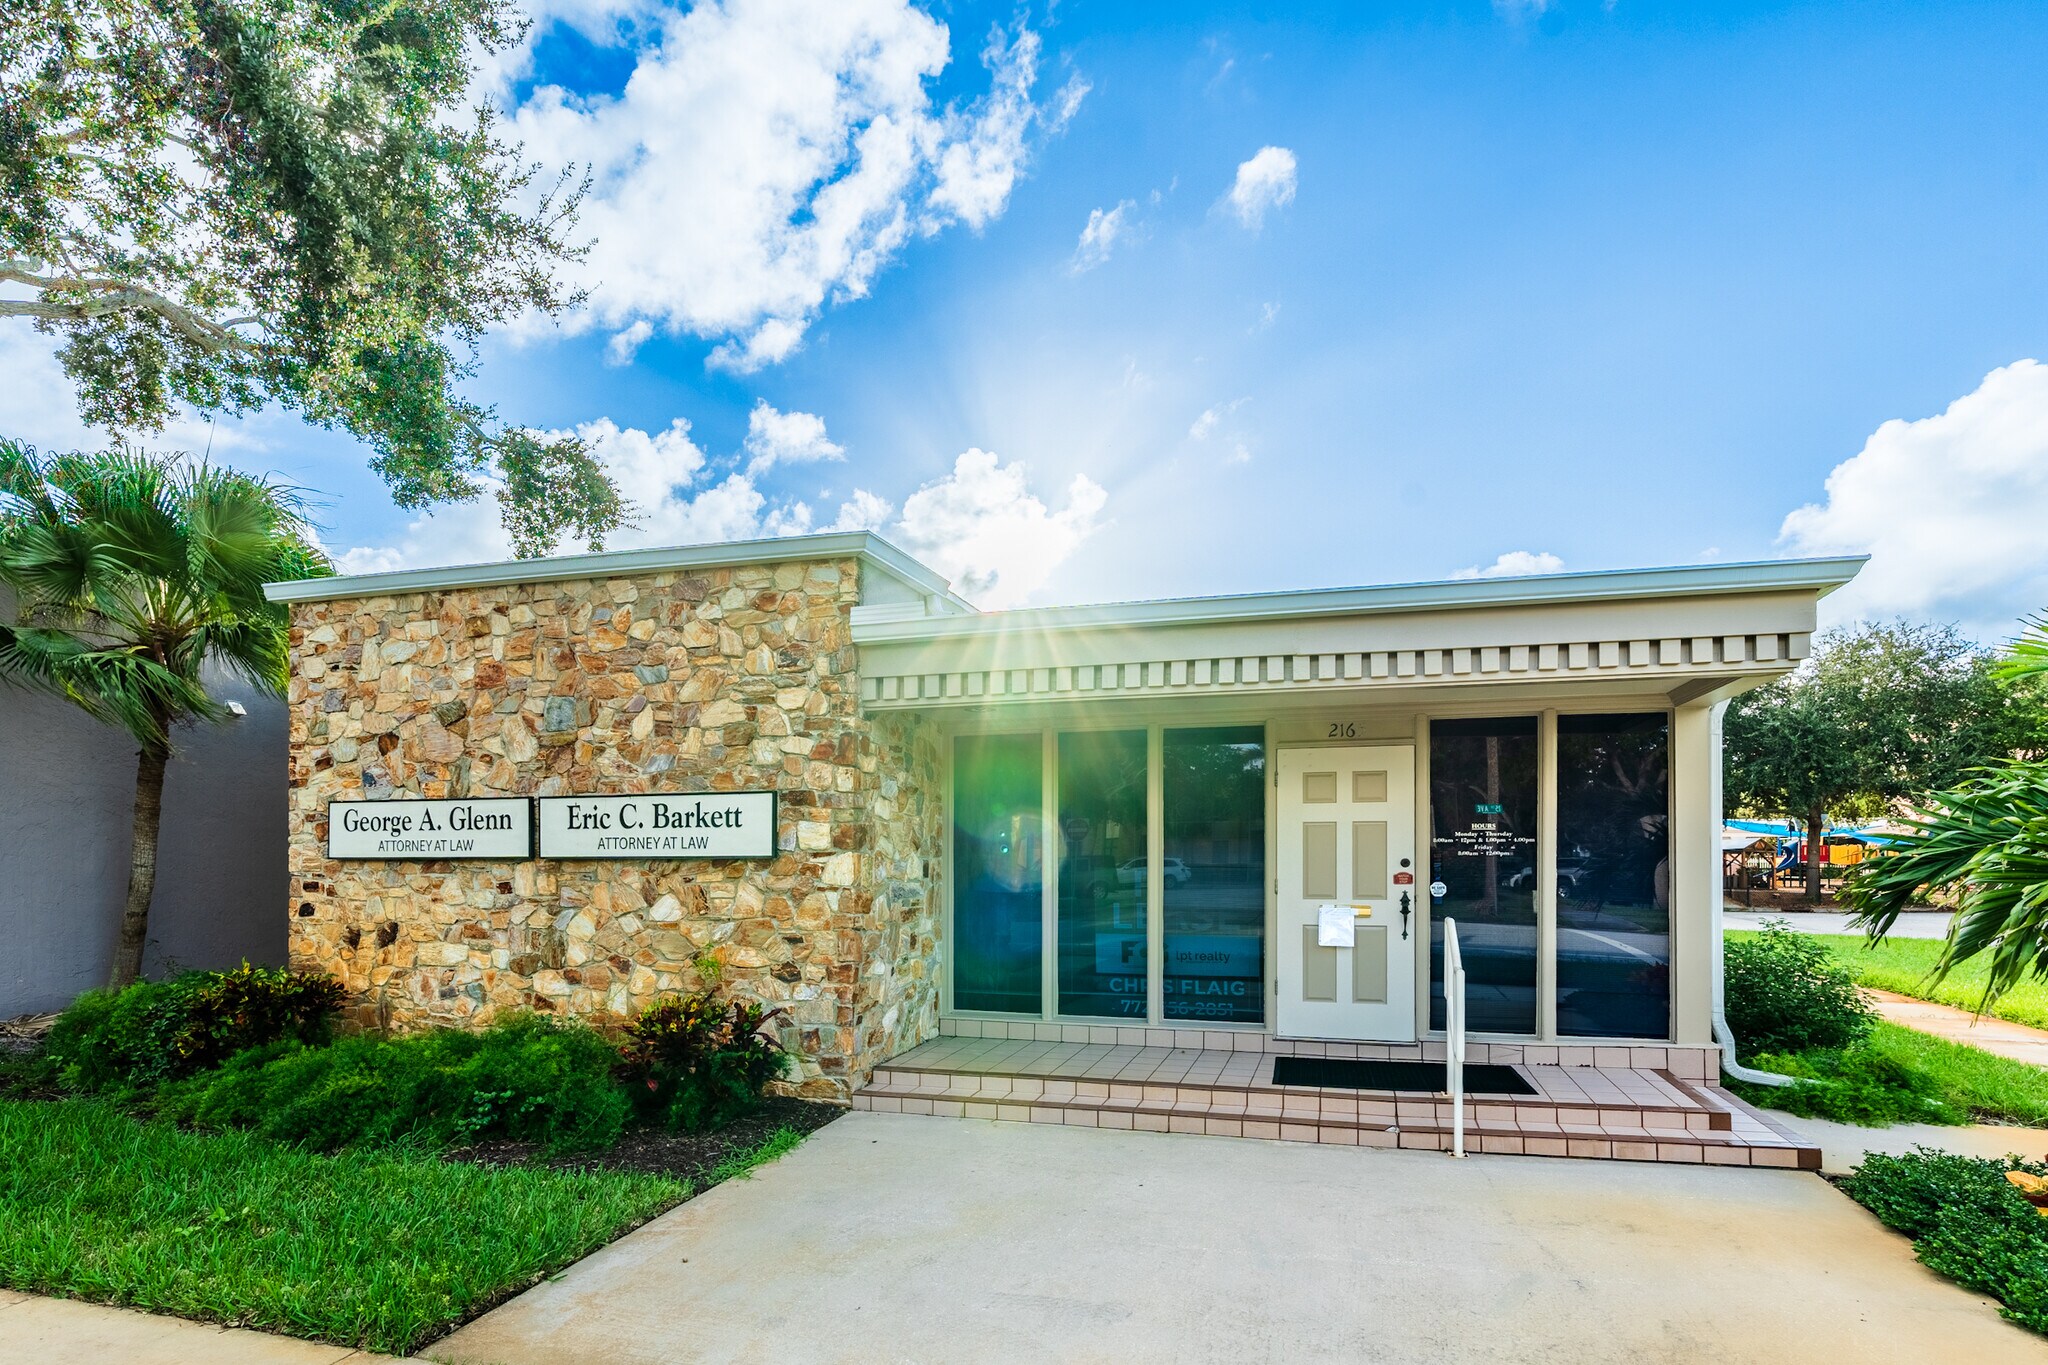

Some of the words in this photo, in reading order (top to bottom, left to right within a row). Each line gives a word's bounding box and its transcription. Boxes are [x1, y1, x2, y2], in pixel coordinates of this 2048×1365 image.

[1328, 722, 1355, 738] 216
[343, 808, 412, 837] George
[418, 807, 442, 832] A.
[450, 805, 513, 831] Glenn
[567, 804, 611, 830] Eric
[619, 803, 643, 830] C.
[652, 801, 743, 829] Barkett
[378, 839, 433, 853] ATTORNEY
[434, 839, 447, 852] AT
[450, 839, 474, 852] LAW
[597, 837, 660, 851] ATTORNEY
[662, 837, 679, 850] AT
[681, 836, 709, 850] LAW
[1176, 951, 1193, 962] lpt
[1194, 951, 1231, 964] realty
[1109, 977, 1173, 993] CHS
[1181, 980, 1246, 996] FLAIG
